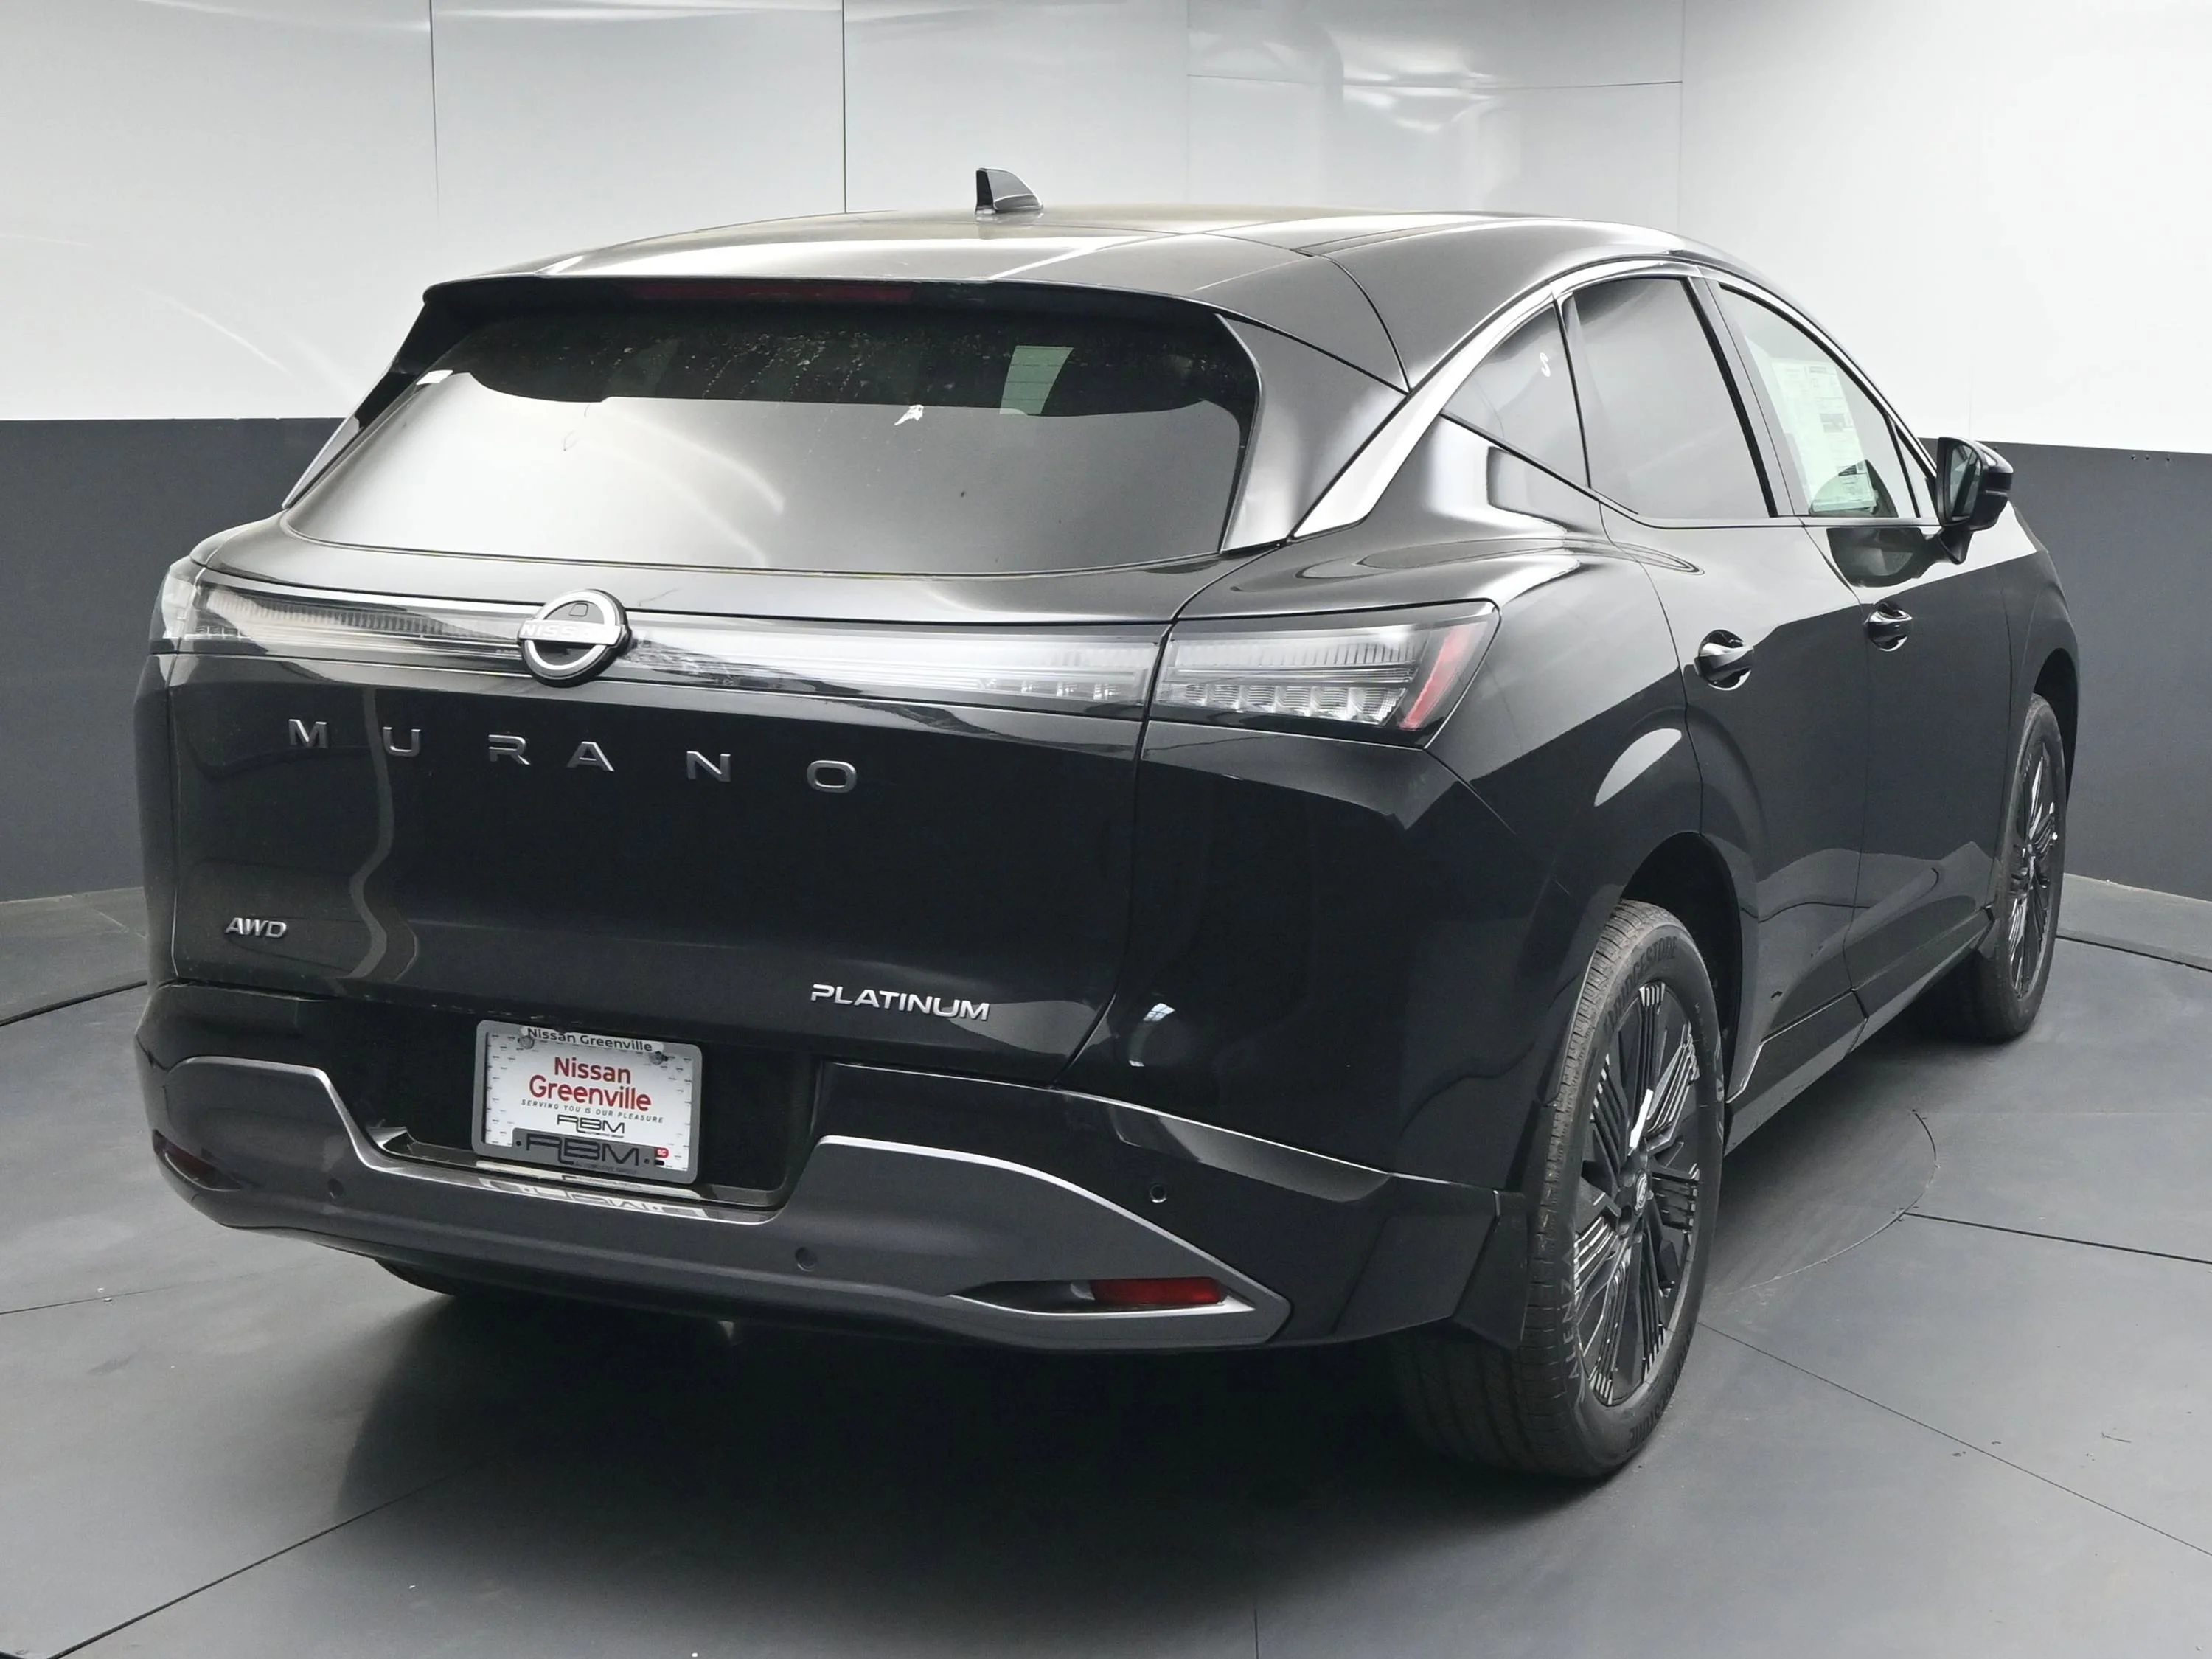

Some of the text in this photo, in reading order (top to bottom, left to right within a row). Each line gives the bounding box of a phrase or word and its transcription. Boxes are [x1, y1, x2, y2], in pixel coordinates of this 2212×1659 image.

[288, 718, 858, 793] MURANO
[225, 917, 287, 938] AWD
[811, 984, 990, 1021] PLATINUM
[527, 1027, 653, 1052] Nissan Greenville
[554, 1057, 631, 1084] Nissan
[529, 1074, 652, 1111] Greenville
[521, 1099, 559, 1110] SERVING
[596, 1109, 613, 1117] OUR
[618, 1112, 664, 1124] PLEASURE
